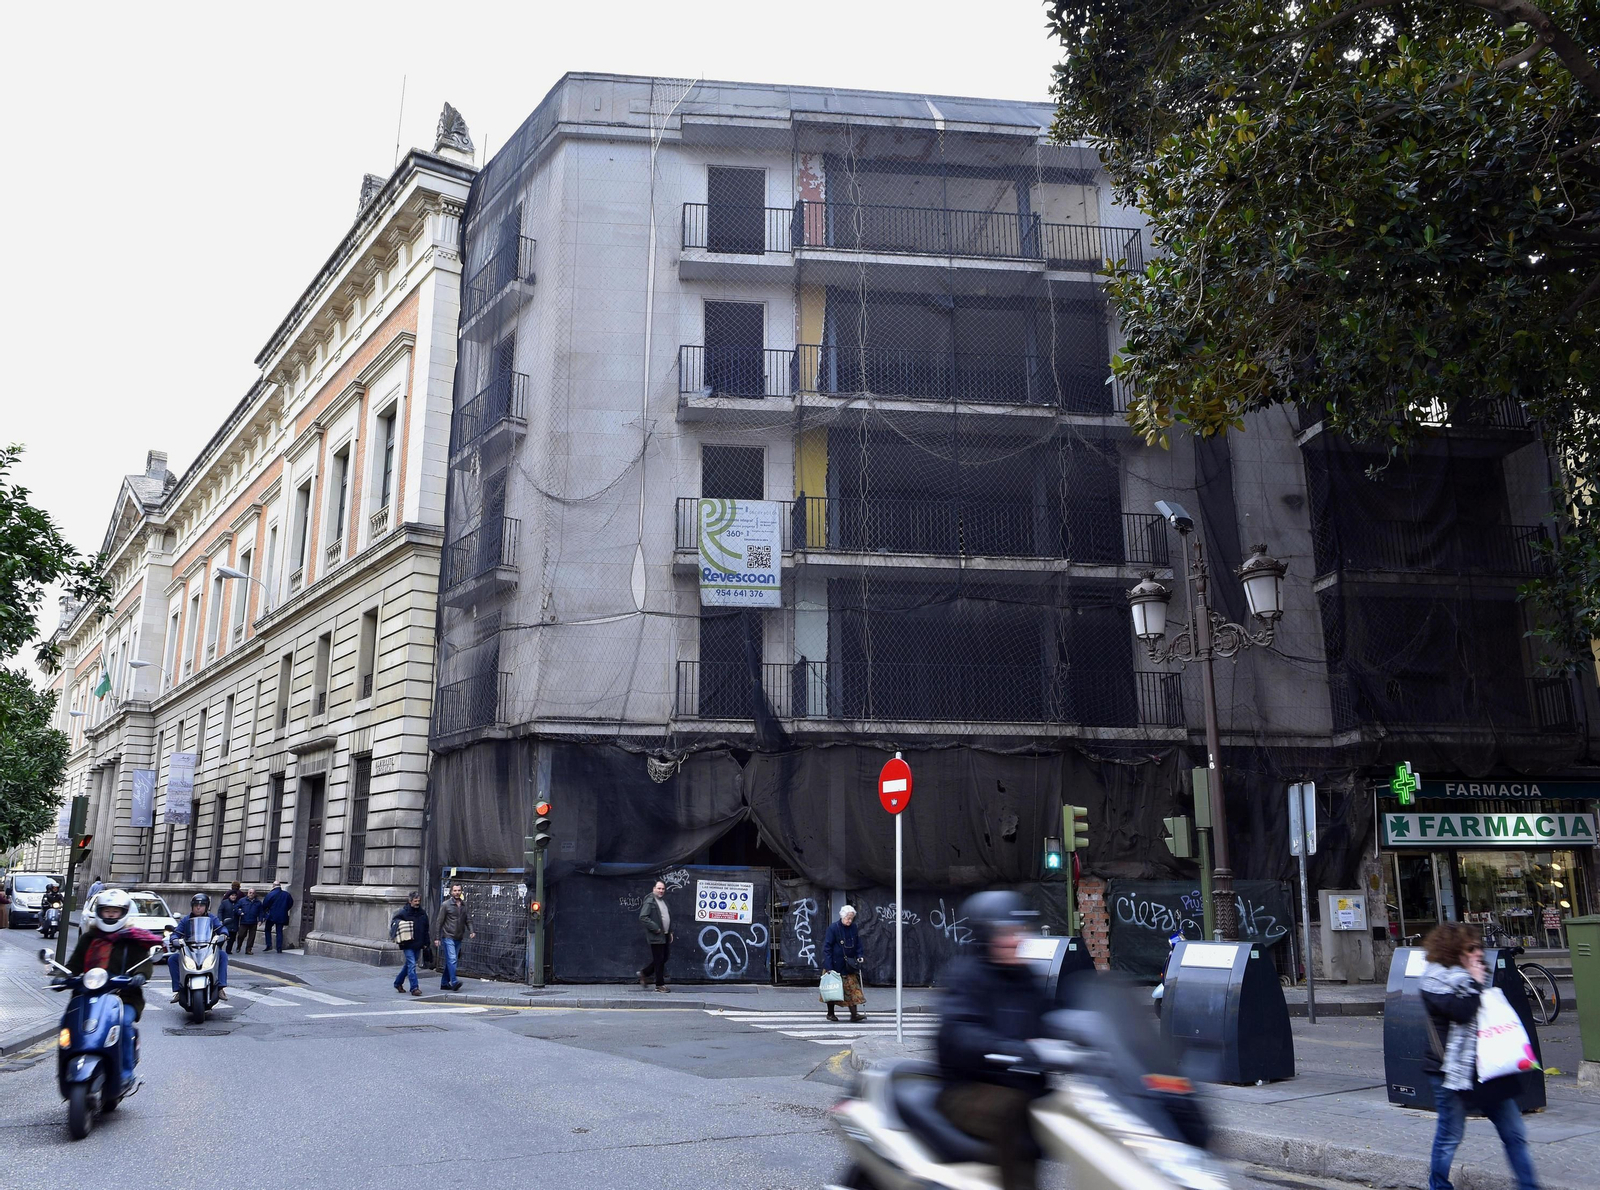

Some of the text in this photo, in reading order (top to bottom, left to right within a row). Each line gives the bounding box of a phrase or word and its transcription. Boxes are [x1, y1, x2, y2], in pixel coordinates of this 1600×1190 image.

[702, 568, 776, 584] Revescoan
[715, 588, 764, 598] 954 641 376
[1445, 783, 1542, 797] FARMACIA
[1418, 815, 1593, 838] FARMACIA
